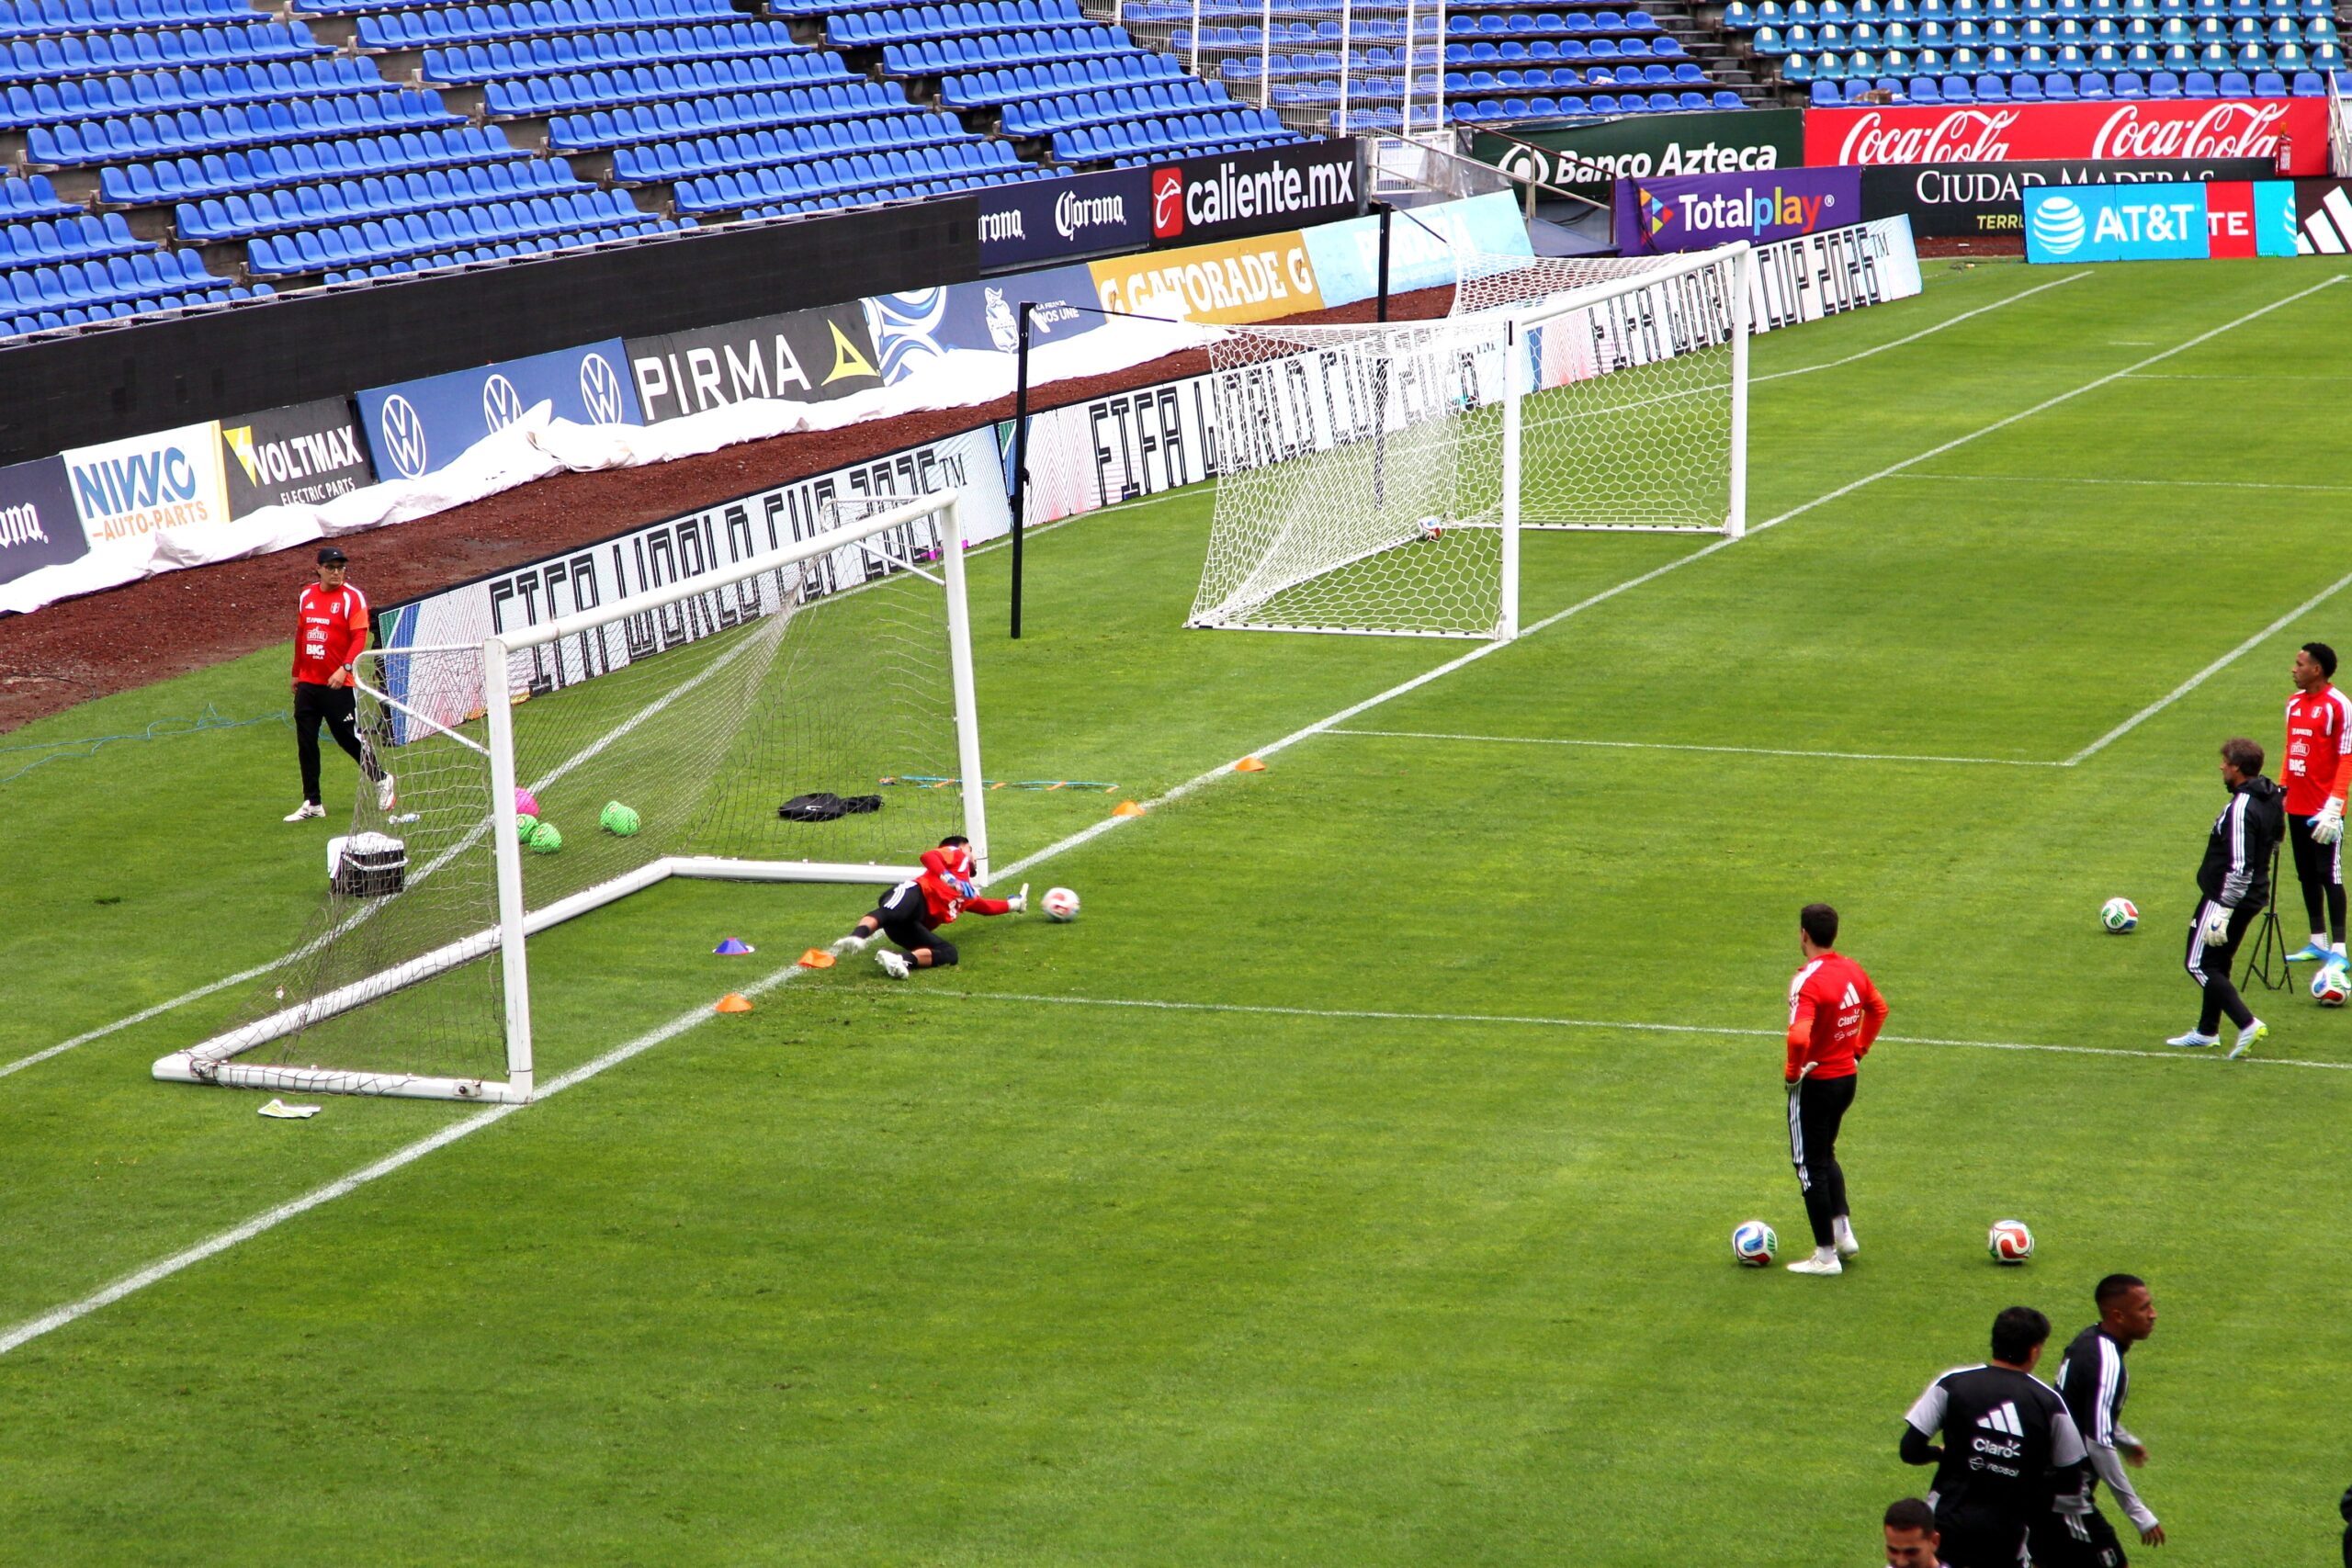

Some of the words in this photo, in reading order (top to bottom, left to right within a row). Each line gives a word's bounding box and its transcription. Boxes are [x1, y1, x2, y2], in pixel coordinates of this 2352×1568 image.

[1839, 109, 2021, 167] Coca-Cola
[2092, 102, 2290, 160] Coca-Cola
[1555, 150, 1652, 185] Banco
[1656, 141, 1778, 177] Azteca
[1055, 190, 1125, 242] Corona
[1186, 160, 1355, 226] caliente.mx
[2093, 203, 2196, 243] AT&T
[2207, 211, 2249, 236] TE
[1126, 251, 1288, 319] GATORADE
[1757, 240, 1811, 332] CUP
[1058, 307, 1080, 321] UNE
[633, 333, 812, 422] PIRMA
[249, 424, 364, 486] VOLTMAX
[1089, 386, 1189, 506] FIFA
[279, 483, 327, 506] ELECTRIC
[326, 476, 356, 499] PARTS
[489, 552, 610, 698] FIFA
[763, 477, 837, 608] CUP
[306, 644, 325, 656] BIG
[2289, 759, 2306, 773] BIG
[1973, 1438, 2013, 1459] Claro
